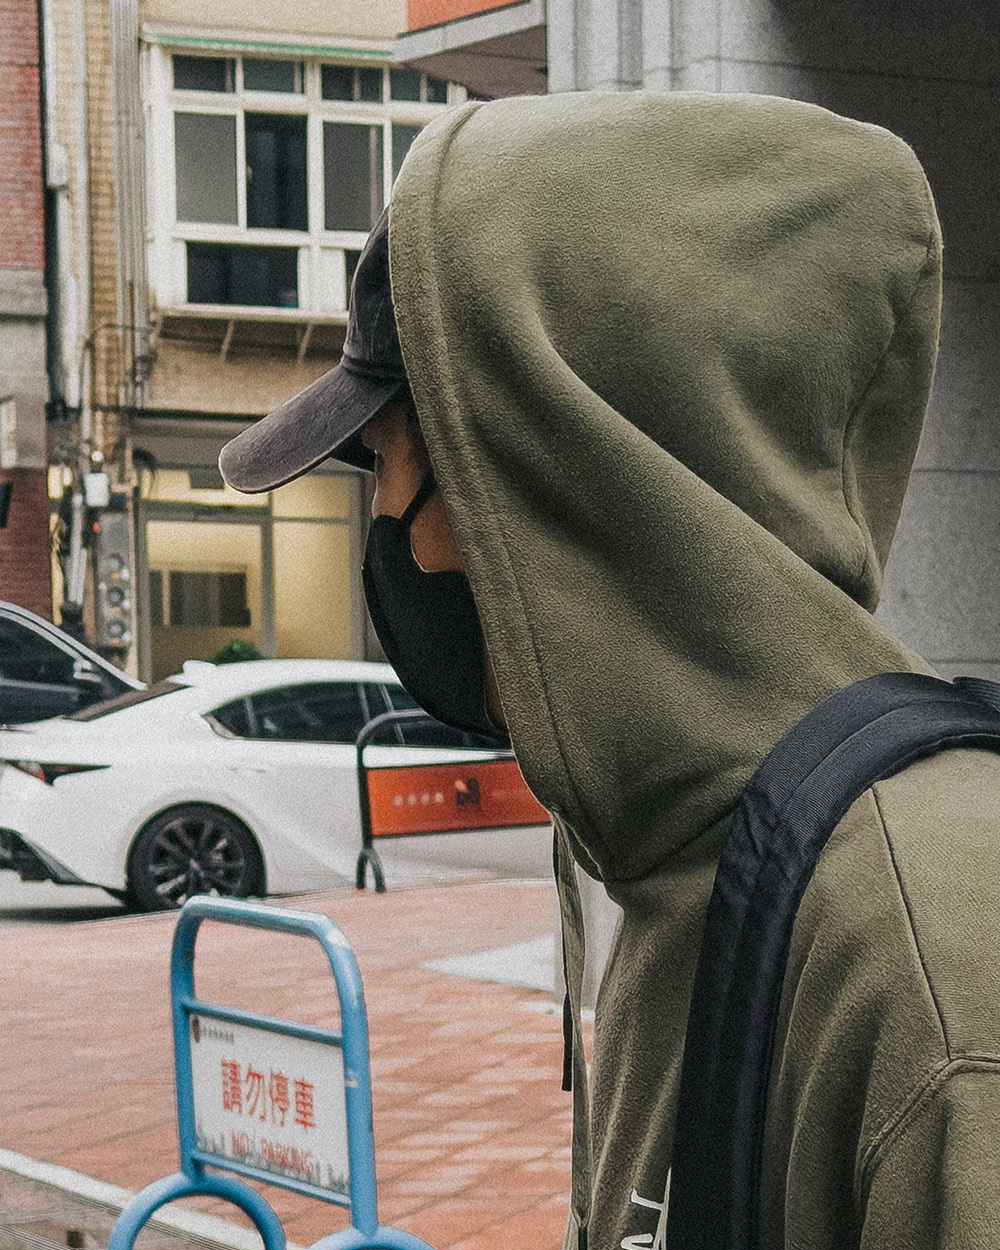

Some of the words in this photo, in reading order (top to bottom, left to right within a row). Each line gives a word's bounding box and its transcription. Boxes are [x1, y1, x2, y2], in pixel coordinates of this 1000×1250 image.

[220, 1057, 316, 1131] 請勿停車
[231, 1129, 250, 1158] NO
[260, 1138, 314, 1177] PARKING
